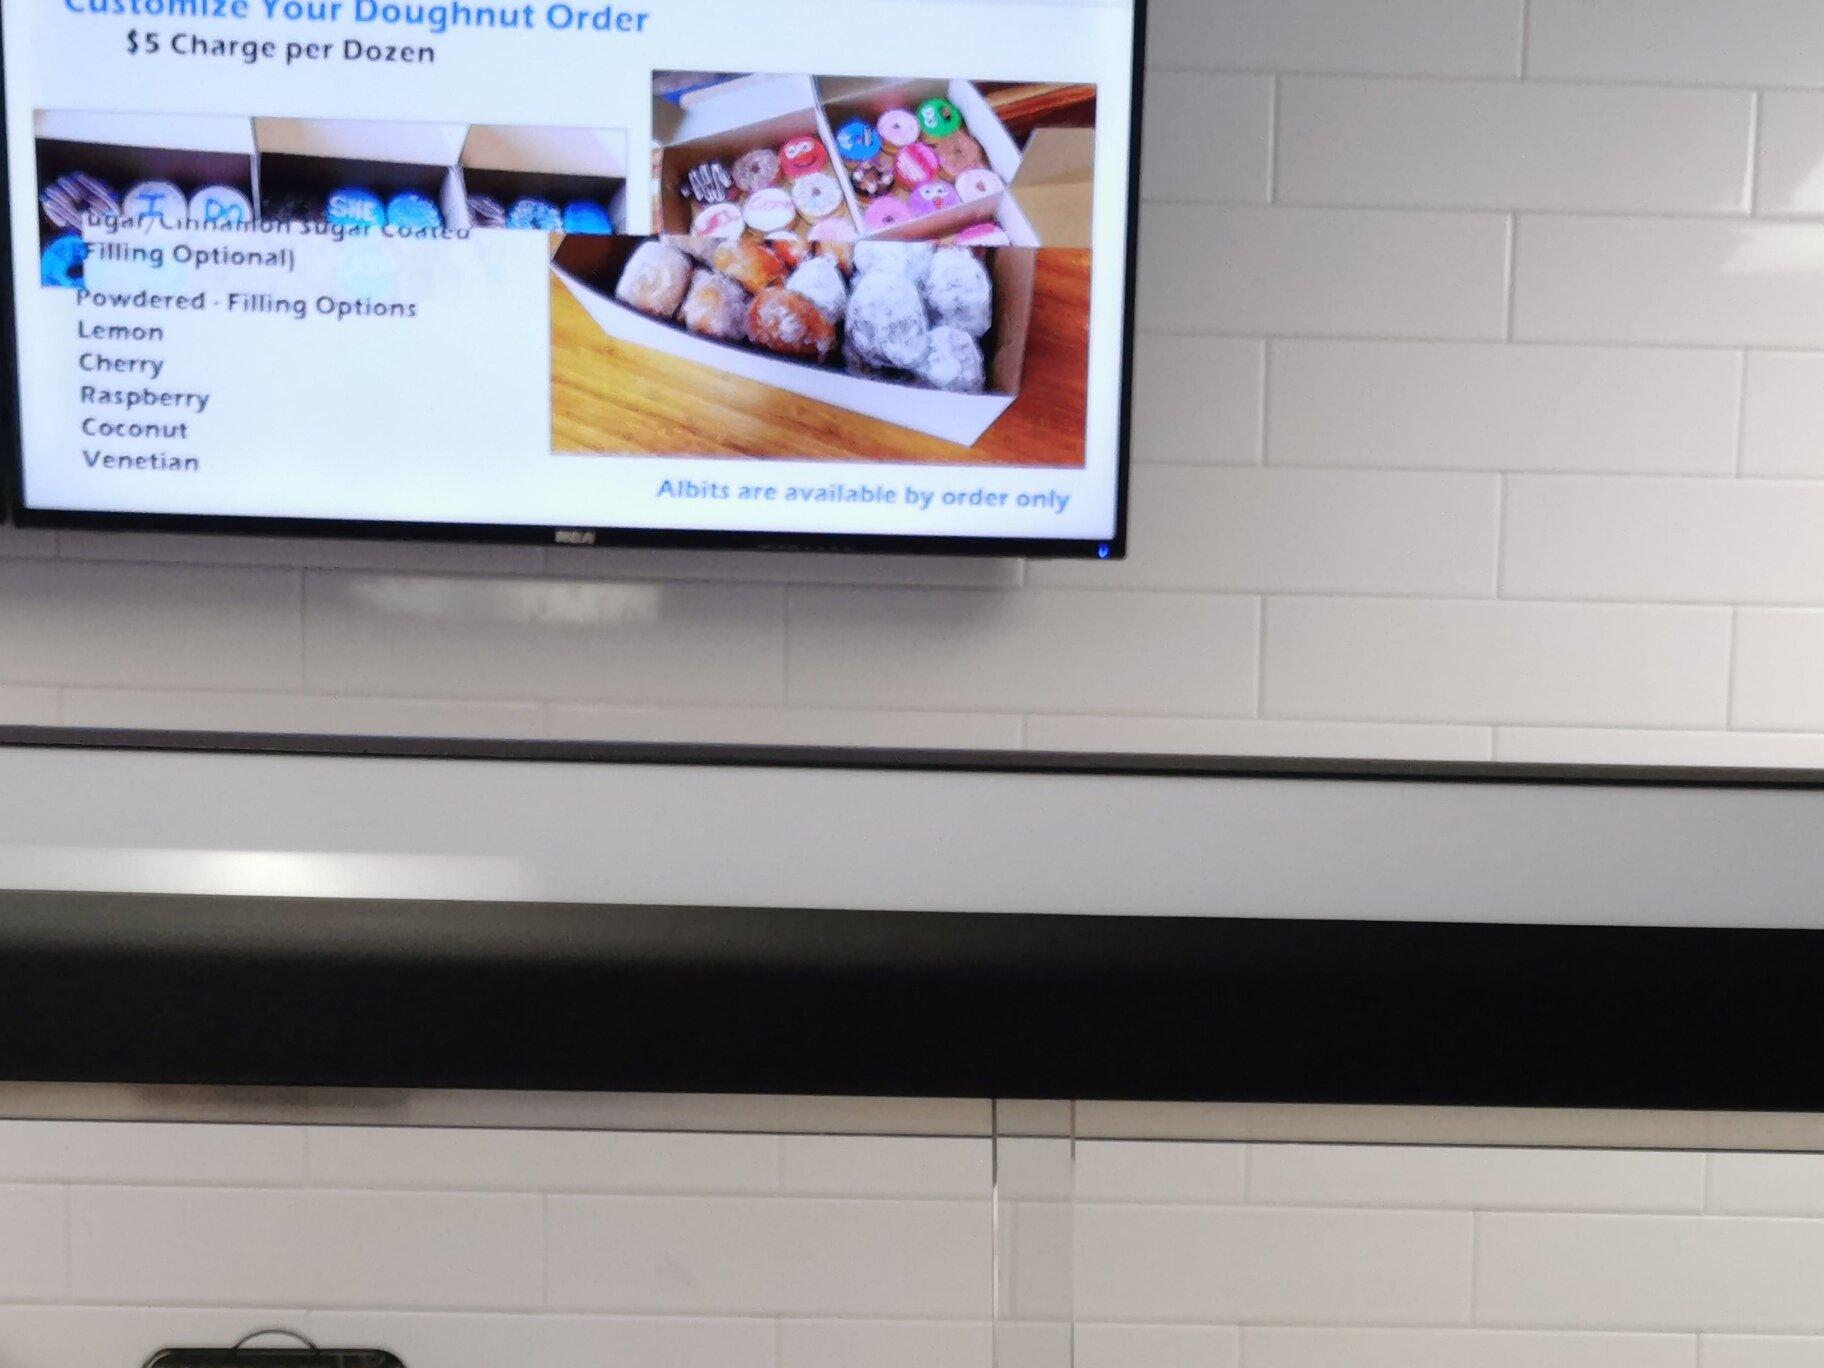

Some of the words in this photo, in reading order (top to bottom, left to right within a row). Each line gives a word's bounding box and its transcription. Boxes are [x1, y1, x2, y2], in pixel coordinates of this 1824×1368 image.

[264, 0, 340, 22] Your
[355, 0, 534, 33] Doughnut
[546, 2, 650, 32] Order
[127, 29, 160, 54] $5
[172, 32, 276, 64] Charge
[286, 40, 333, 66] per
[343, 39, 436, 63] Dozen
[174, 245, 296, 271] Optional)
[77, 290, 205, 311] Powdered
[227, 293, 307, 320] Filling
[316, 296, 417, 321] Options
[78, 320, 164, 342] Lemon
[79, 353, 164, 380] Cherry
[81, 386, 210, 413] Raspberry
[82, 418, 188, 440] Coconut
[83, 449, 199, 473] Venetian
[656, 479, 729, 500] Albits
[738, 485, 778, 502] are
[785, 484, 897, 505] available
[905, 486, 933, 511] by
[943, 488, 1008, 508] order
[1016, 489, 1070, 514] only
